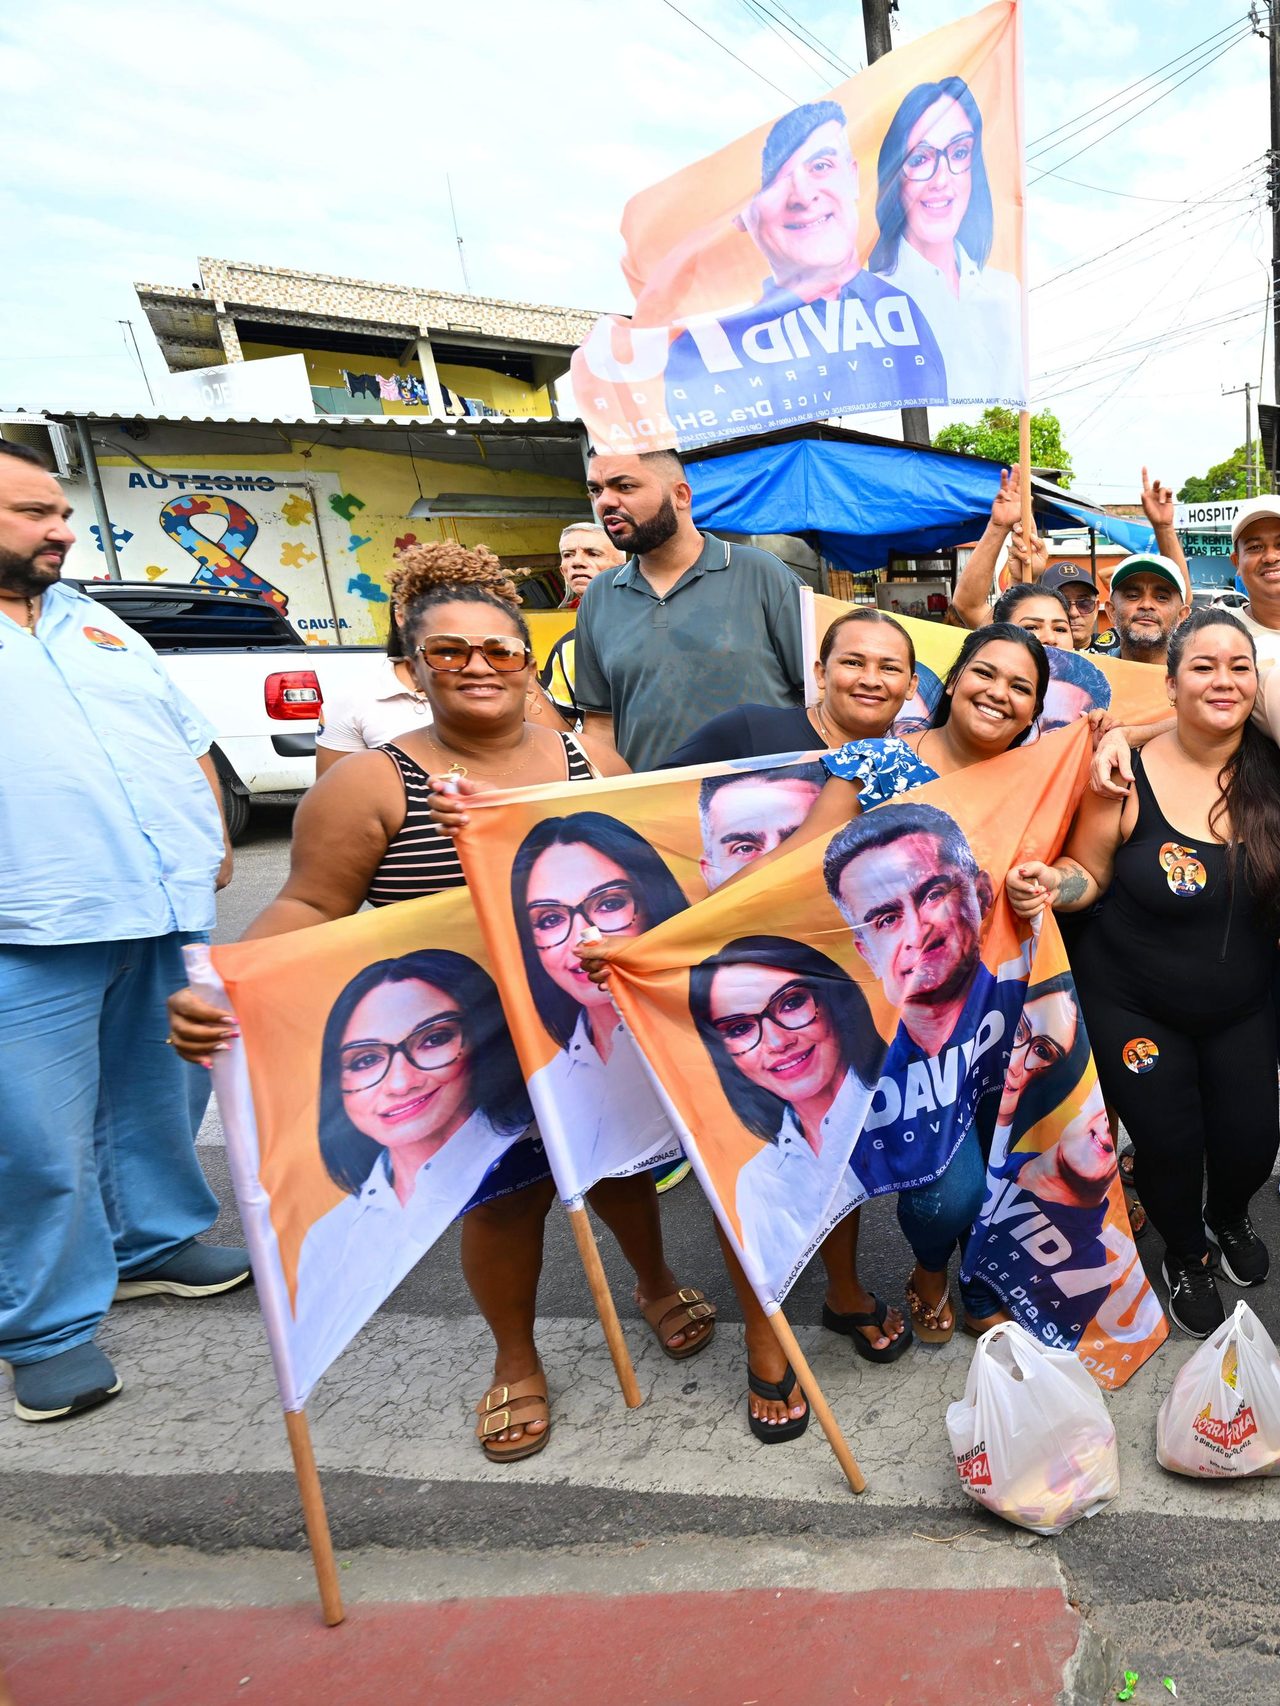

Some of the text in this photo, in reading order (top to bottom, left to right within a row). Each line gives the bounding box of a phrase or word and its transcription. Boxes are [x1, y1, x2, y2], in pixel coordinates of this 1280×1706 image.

[128, 472, 275, 492] AUTISMO
[1184, 883, 1196, 892] 70
[1142, 1058, 1153, 1066] 70
[1009, 1286, 1039, 1324] Dra.
[1041, 1322, 1117, 1381] SHDIA
